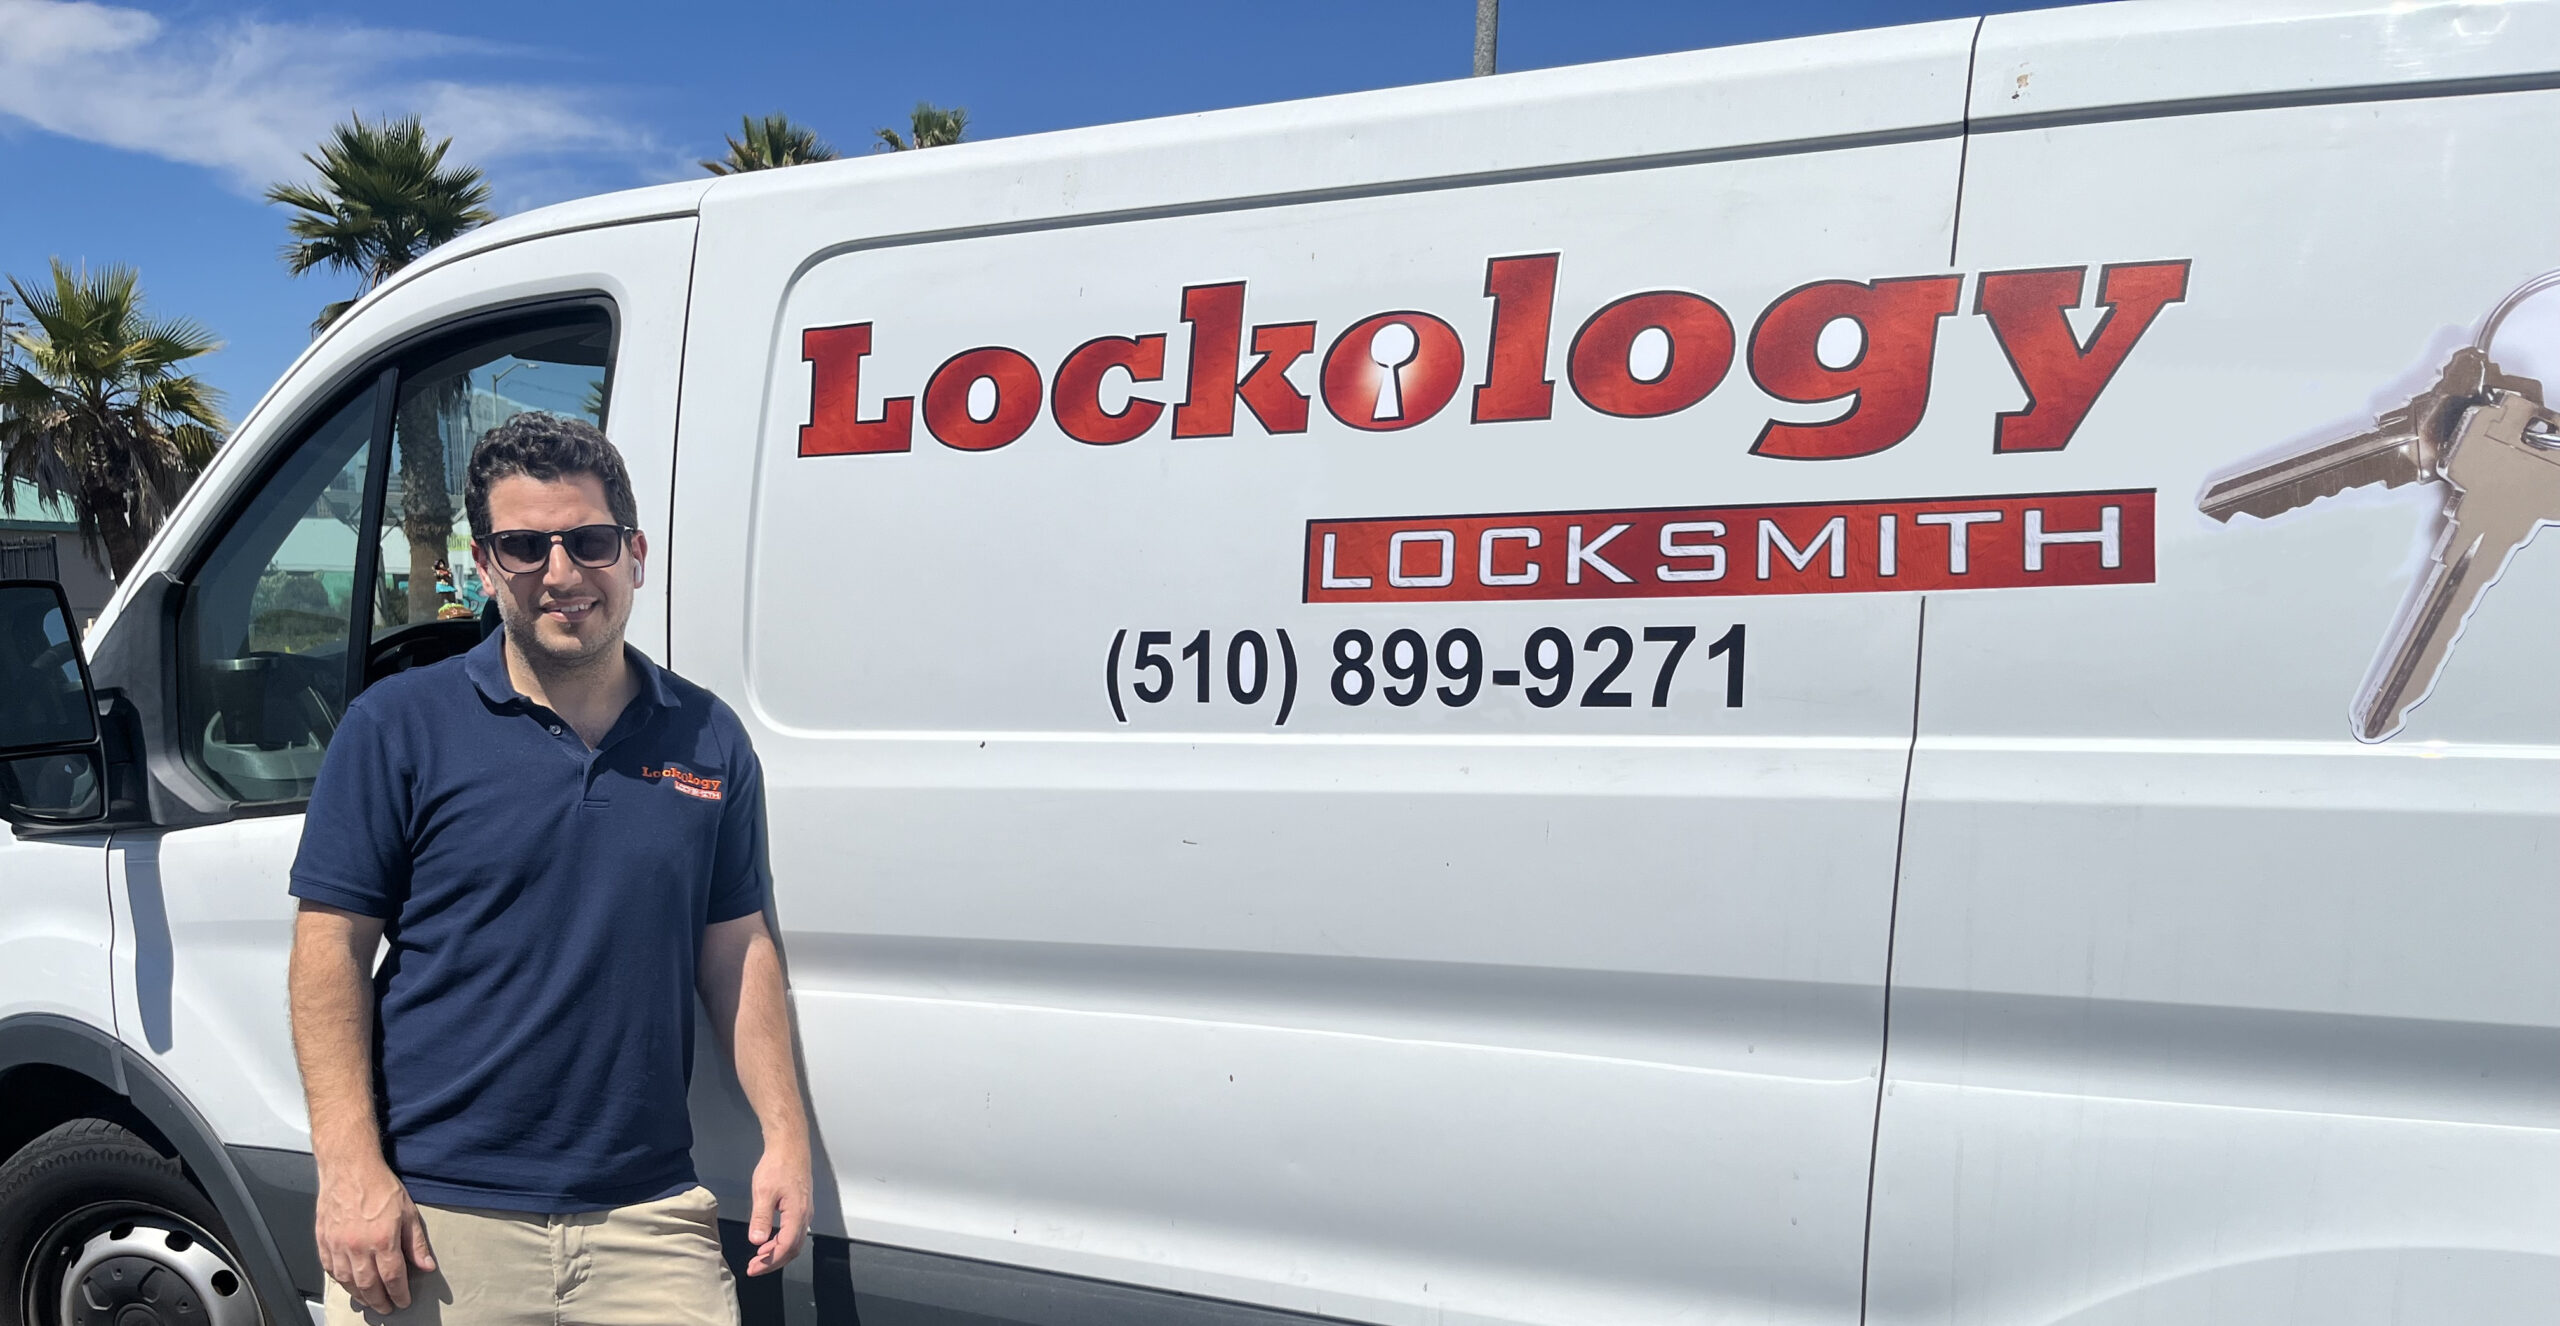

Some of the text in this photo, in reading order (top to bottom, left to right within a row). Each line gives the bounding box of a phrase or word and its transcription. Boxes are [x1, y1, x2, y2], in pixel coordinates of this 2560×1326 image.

[798, 253, 2191, 460] Lockology
[1320, 504, 2122, 590] LOCKSMITH
[1105, 624, 1747, 724] (510) 899-9271
[642, 766, 722, 790] Lockology
